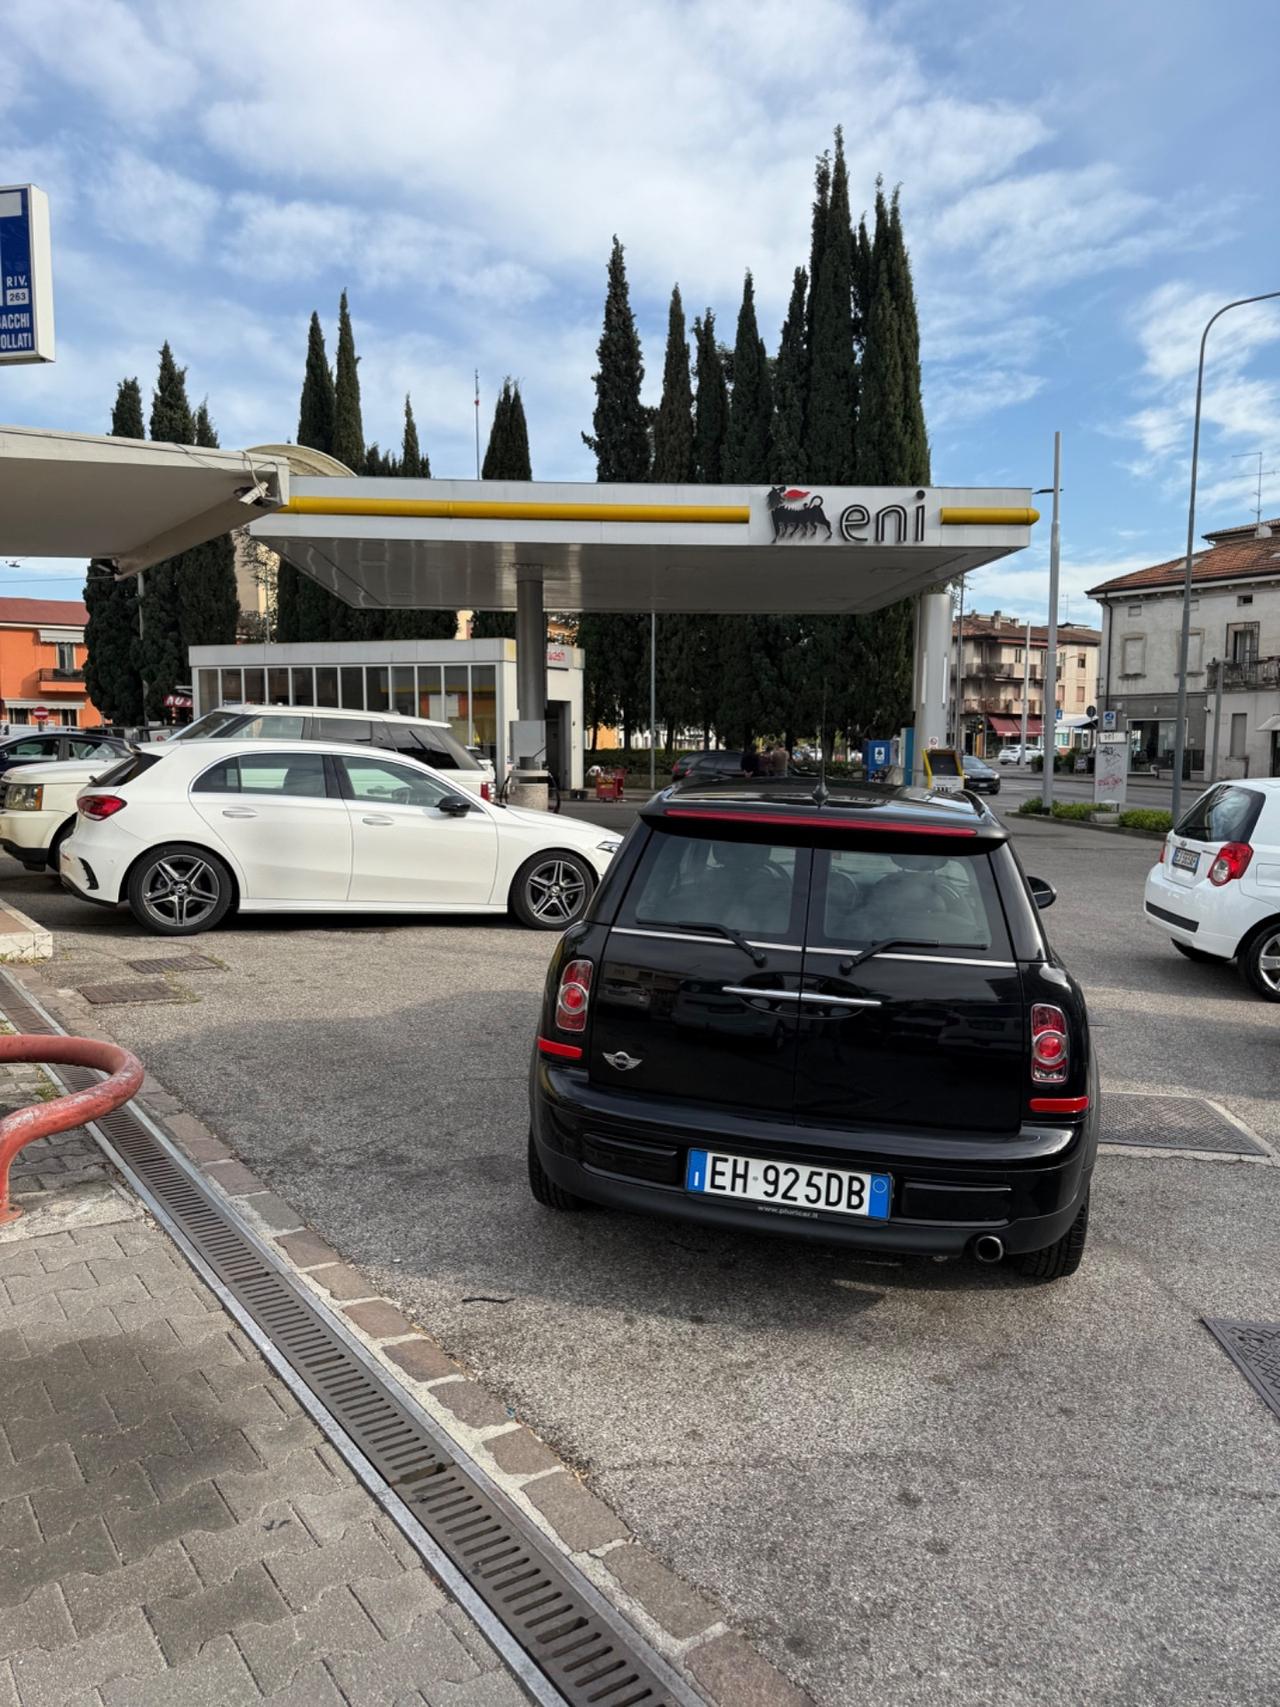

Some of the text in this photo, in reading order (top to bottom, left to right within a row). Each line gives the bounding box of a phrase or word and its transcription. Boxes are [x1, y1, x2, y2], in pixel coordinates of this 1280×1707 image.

[6, 275, 28, 287] RIV.
[9, 292, 26, 302] 263
[0, 313, 30, 329] ACCHI
[839, 489, 926, 542] eni
[709, 1156, 750, 1194] EH
[762, 1164, 867, 1210] 925DB
